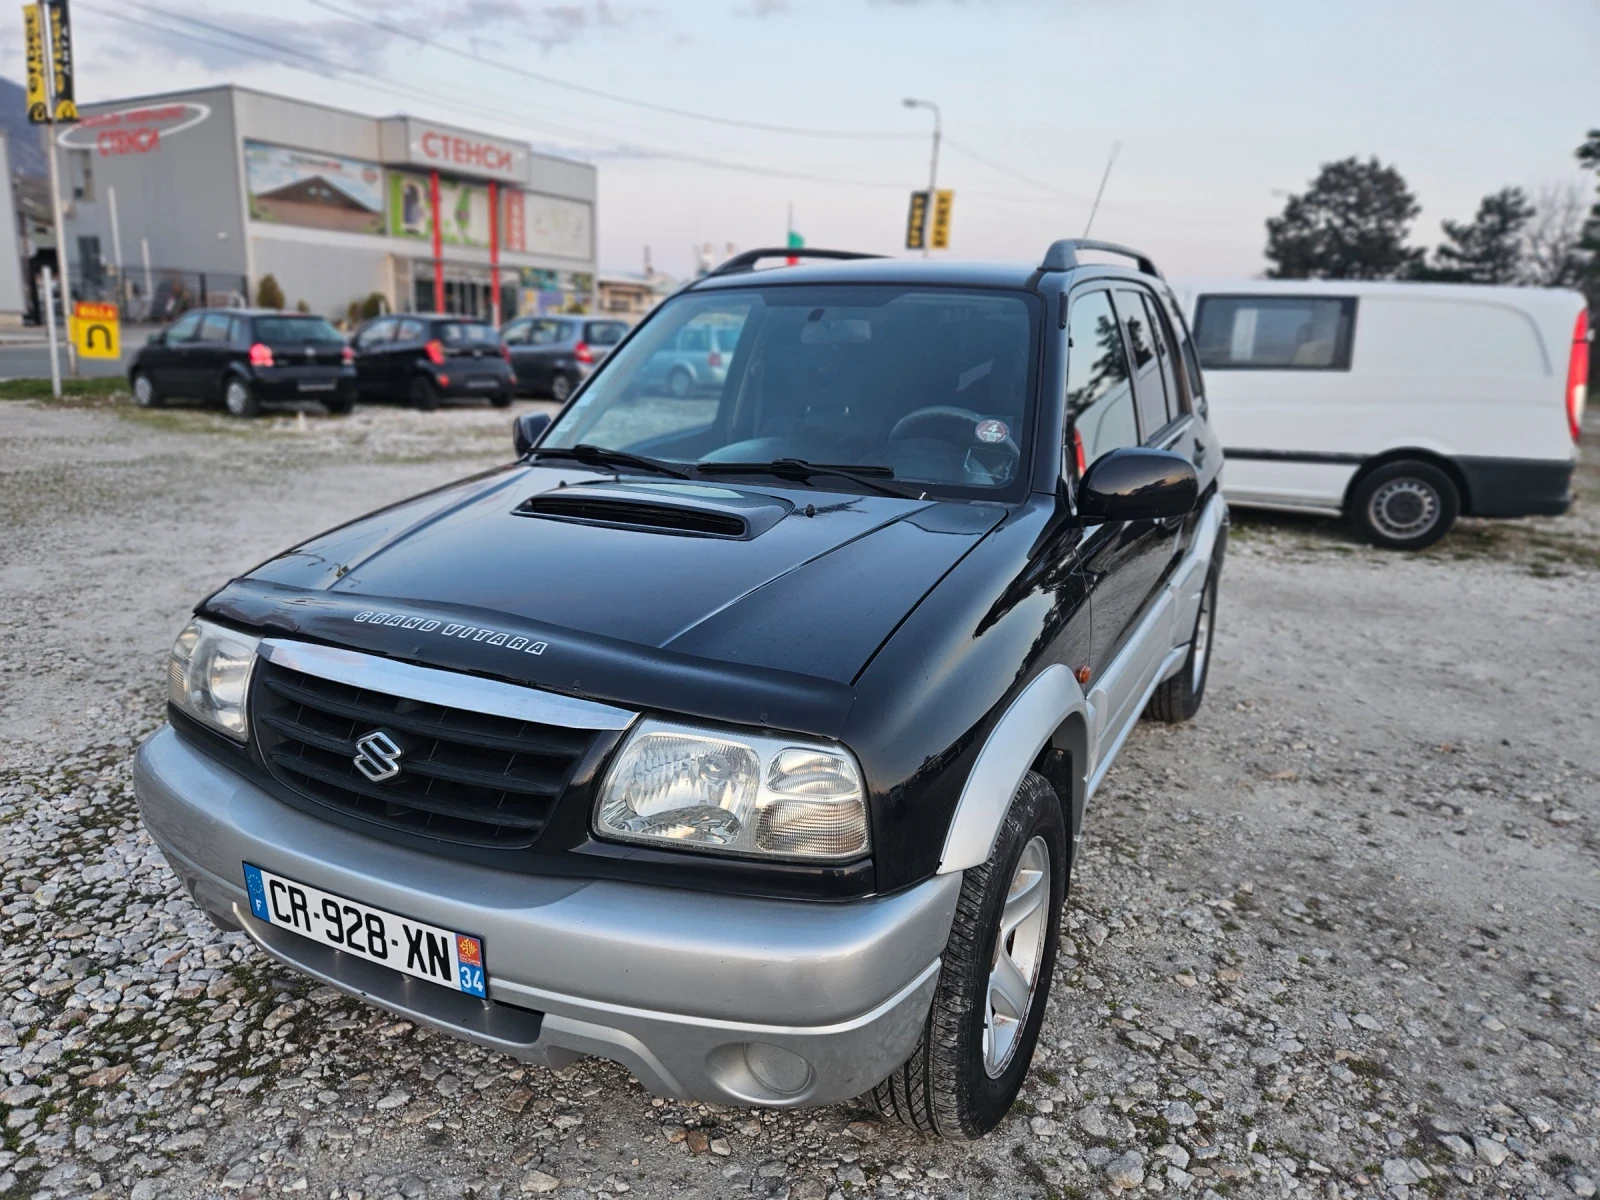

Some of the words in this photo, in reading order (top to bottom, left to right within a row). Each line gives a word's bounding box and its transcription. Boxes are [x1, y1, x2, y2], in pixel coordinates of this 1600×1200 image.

[421, 131, 512, 172] СТЕНСИ
[353, 611, 441, 632] GRAND
[441, 623, 549, 656] VITARA
[255, 899, 262, 911] F
[269, 879, 452, 982] CR-928-XN
[460, 966, 484, 992] 34
